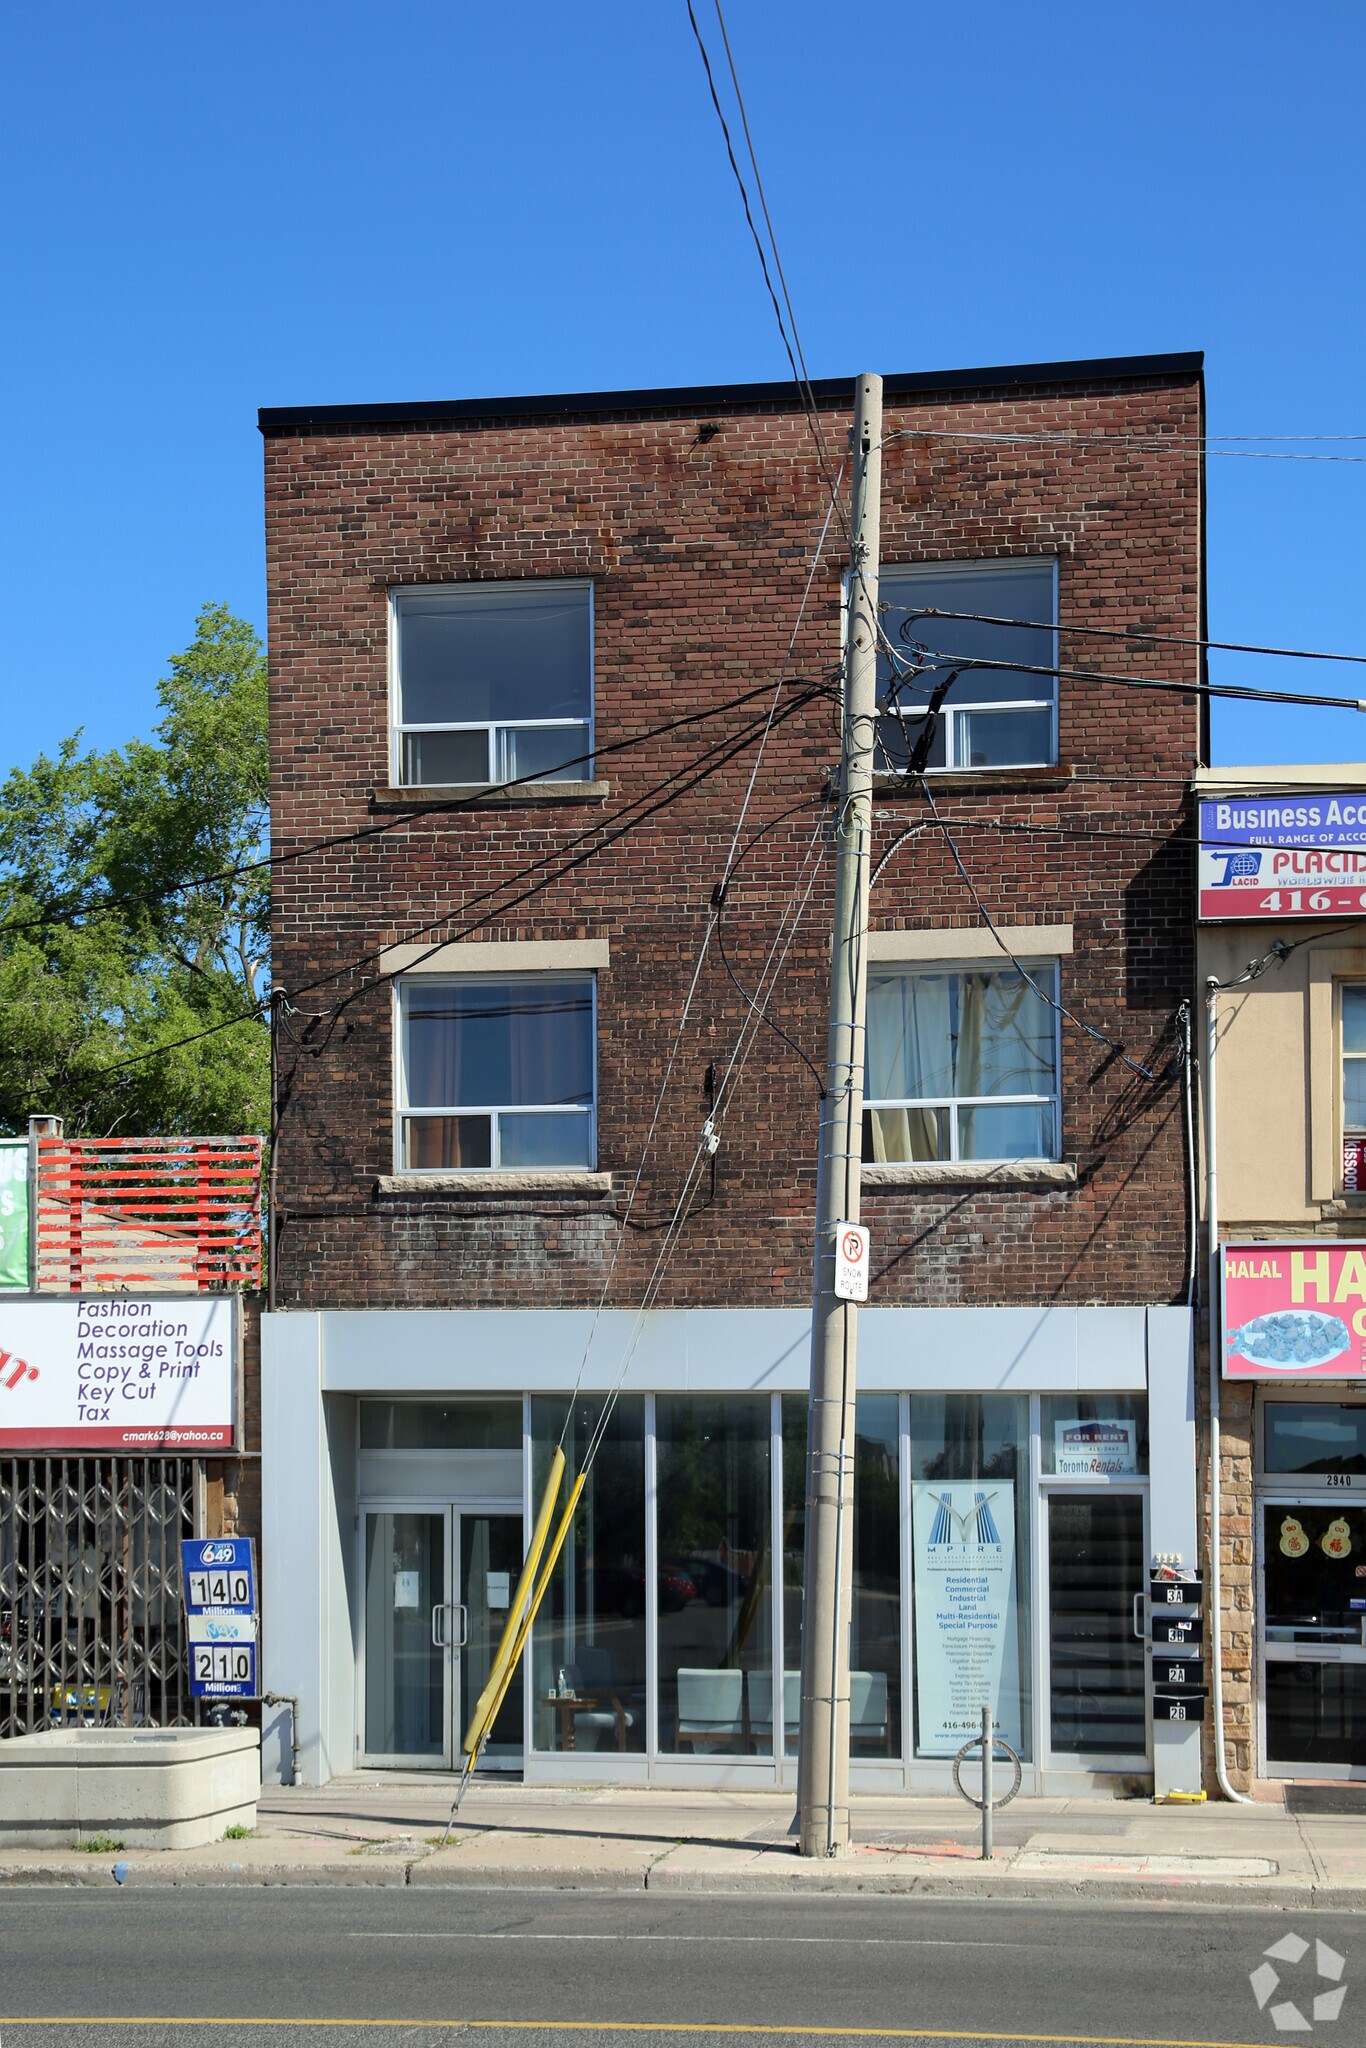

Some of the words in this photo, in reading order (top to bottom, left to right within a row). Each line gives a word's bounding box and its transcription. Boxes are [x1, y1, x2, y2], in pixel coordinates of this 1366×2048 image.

[1216, 803, 1321, 830] Business
[1249, 836, 1274, 845] FULL
[1278, 834, 1315, 844] RANGE
[1319, 833, 1334, 842] OF
[842, 1266, 862, 1279] SNOW
[1225, 1260, 1282, 1279] HALAL
[840, 1279, 863, 1293] ROUTE
[77, 1299, 152, 1318] Fashion
[77, 1320, 188, 1339] Decoration
[77, 1342, 168, 1362] Massage
[175, 1340, 224, 1358] Tools
[77, 1362, 132, 1383] Copy
[139, 1363, 151, 1379] &
[159, 1361, 201, 1379] Print
[78, 1384, 115, 1404] Key
[122, 1382, 157, 1400] Cut
[78, 1404, 111, 1421] Tax
[122, 1430, 224, 1444] cmark628@yahoo.ca
[1066, 1433, 1090, 1441] FOR
[1094, 1433, 1127, 1441] RENT
[1327, 1475, 1352, 1486] 2940
[927, 1545, 1003, 1553] MPIRE
[946, 1576, 988, 1584] Residential
[1168, 1590, 1183, 1602] 3A
[202, 1606, 235, 1615] Million
[939, 1622, 966, 1630] Special
[967, 1622, 998, 1630] Purpose
[1169, 1630, 1184, 1642] 3B
[1170, 1669, 1184, 1681] 2A
[205, 1683, 237, 1692] Million
[1171, 1707, 1185, 1719] 2B
[942, 1721, 1000, 1729] 416-496-044
